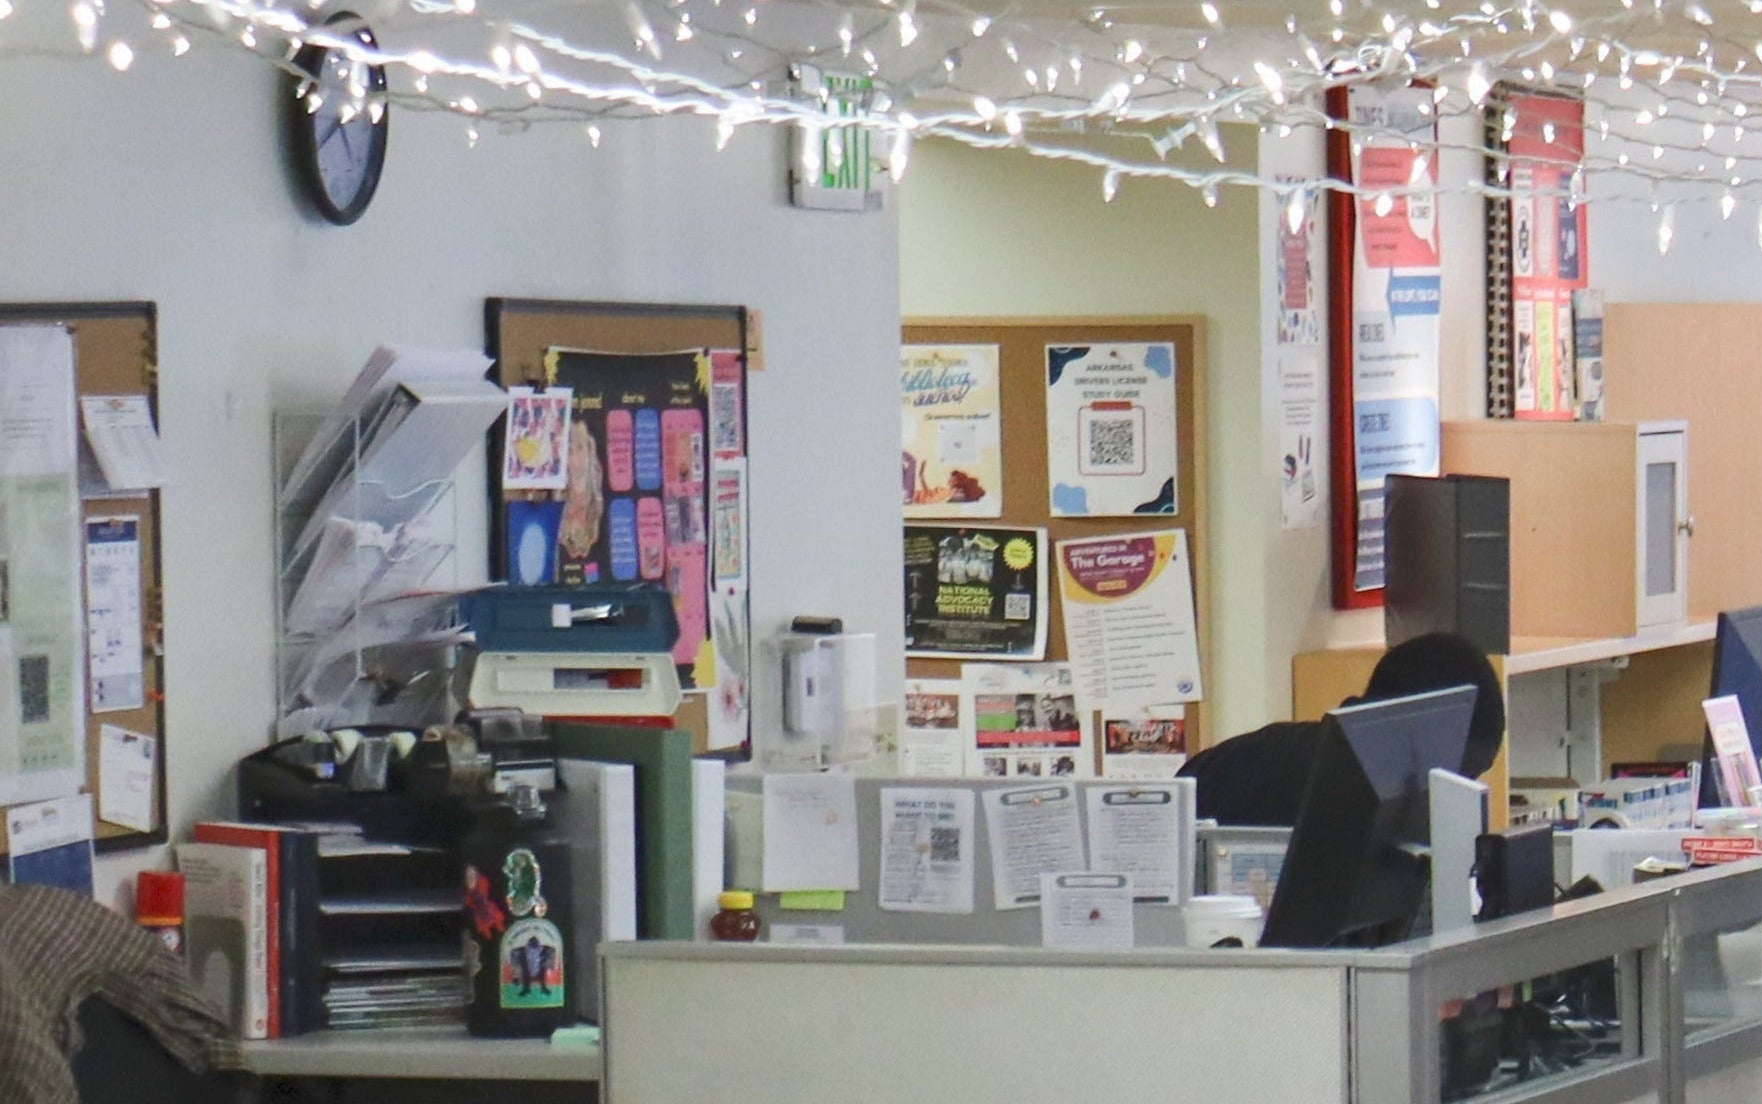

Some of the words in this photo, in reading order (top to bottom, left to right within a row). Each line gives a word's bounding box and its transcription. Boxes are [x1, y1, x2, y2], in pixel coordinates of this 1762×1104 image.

[1071, 556, 1095, 569] The
[1096, 554, 1146, 567] Garage
[938, 585, 991, 596] NATIONAL
[934, 596, 994, 606] ADVOCACY
[937, 605, 991, 615] INSTITUTE
